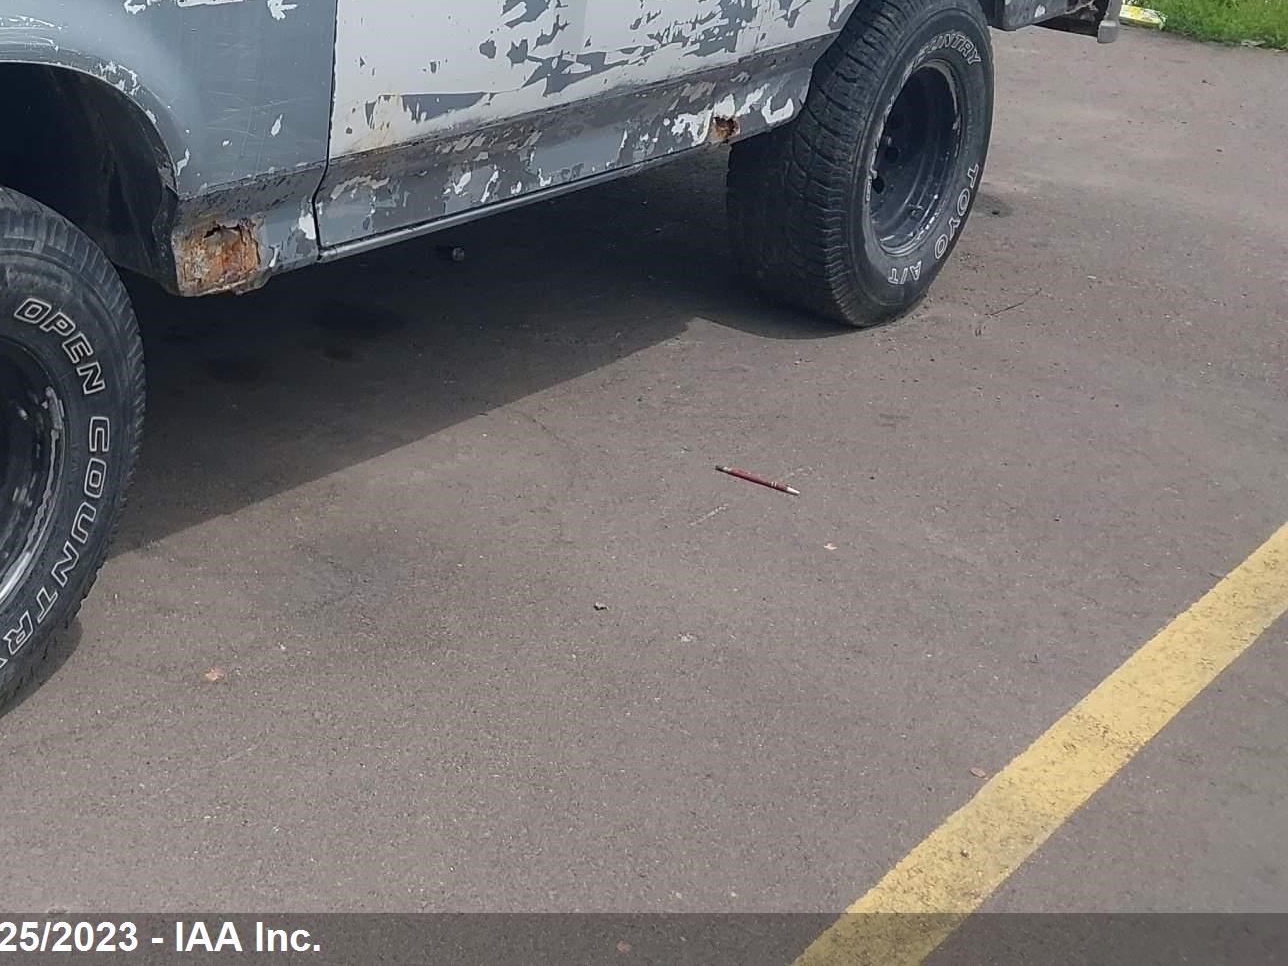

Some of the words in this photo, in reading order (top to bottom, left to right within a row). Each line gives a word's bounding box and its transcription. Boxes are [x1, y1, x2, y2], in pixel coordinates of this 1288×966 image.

[934, 163, 979, 260] TOYO
[888, 260, 923, 286] A/T
[14, 297, 106, 395] OPEN
